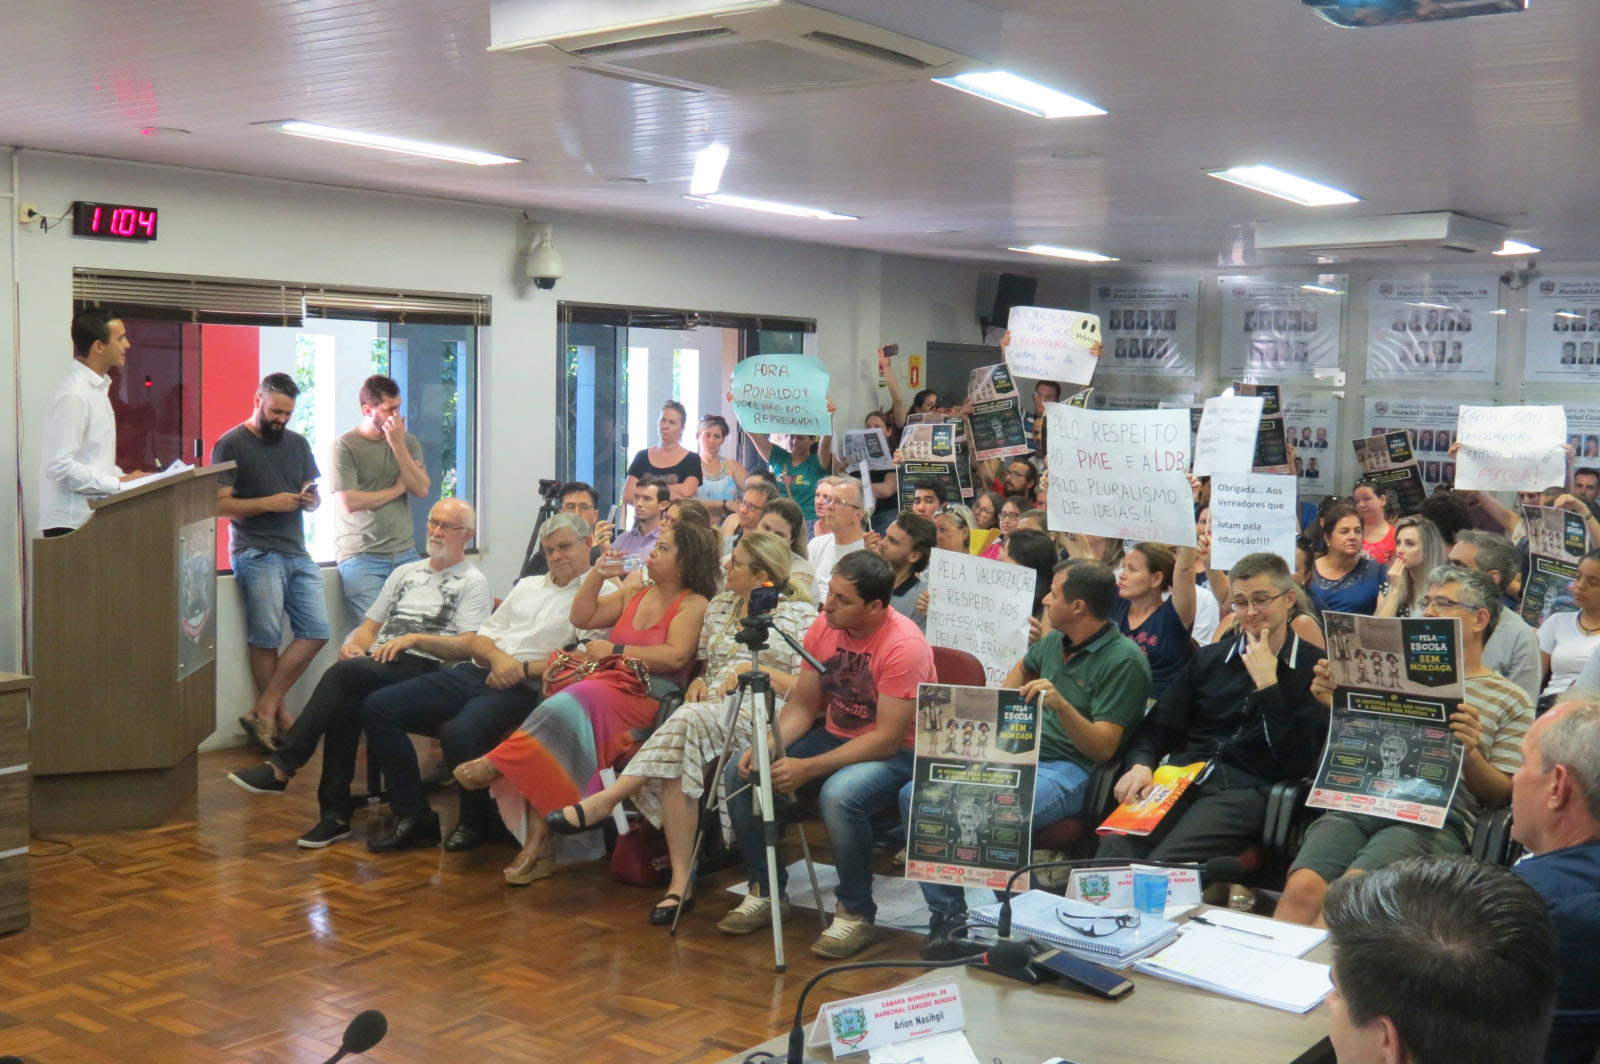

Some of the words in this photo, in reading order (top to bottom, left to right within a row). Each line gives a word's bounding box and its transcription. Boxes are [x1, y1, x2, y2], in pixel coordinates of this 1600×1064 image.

[753, 363, 790, 377] FORA
[786, 404, 809, 415] NOS
[1053, 414, 1080, 441] PELO
[1092, 421, 1178, 444] RESPEITO
[1050, 445, 1064, 466] AO
[1077, 450, 1112, 470] PME
[1126, 455, 1136, 469] E
[1154, 449, 1185, 472] LDB
[1051, 475, 1078, 494] PELO
[1087, 478, 1177, 505] PLURALISMO
[1266, 486, 1283, 495] Aos
[1062, 500, 1081, 515] DE
[1218, 499, 1266, 509] Vereadores
[1267, 502, 1285, 511] que
[1218, 521, 1241, 530] lutam
[1243, 521, 1262, 532] pela
[938, 559, 966, 581] PELA
[975, 565, 1034, 596] VALORIZAÇÃO
[947, 588, 995, 612] RESPEITO
[1000, 601, 1019, 620] AOS
[935, 629, 959, 649] PELA
[1410, 642, 1448, 651] ESCOLA
[1419, 655, 1441, 663] SEM
[1410, 663, 1452, 673] MORDAÇA
[1004, 712, 1033, 721] ESCOLA
[1010, 723, 1027, 732] SEM
[907, 992, 939, 1003] MUNICIPAL
[874, 1007, 905, 1018] MARECHAL
[934, 996, 957, 1006] RONDON
[894, 1020, 913, 1030] Arion
[915, 1010, 945, 1026] Nasihgil
